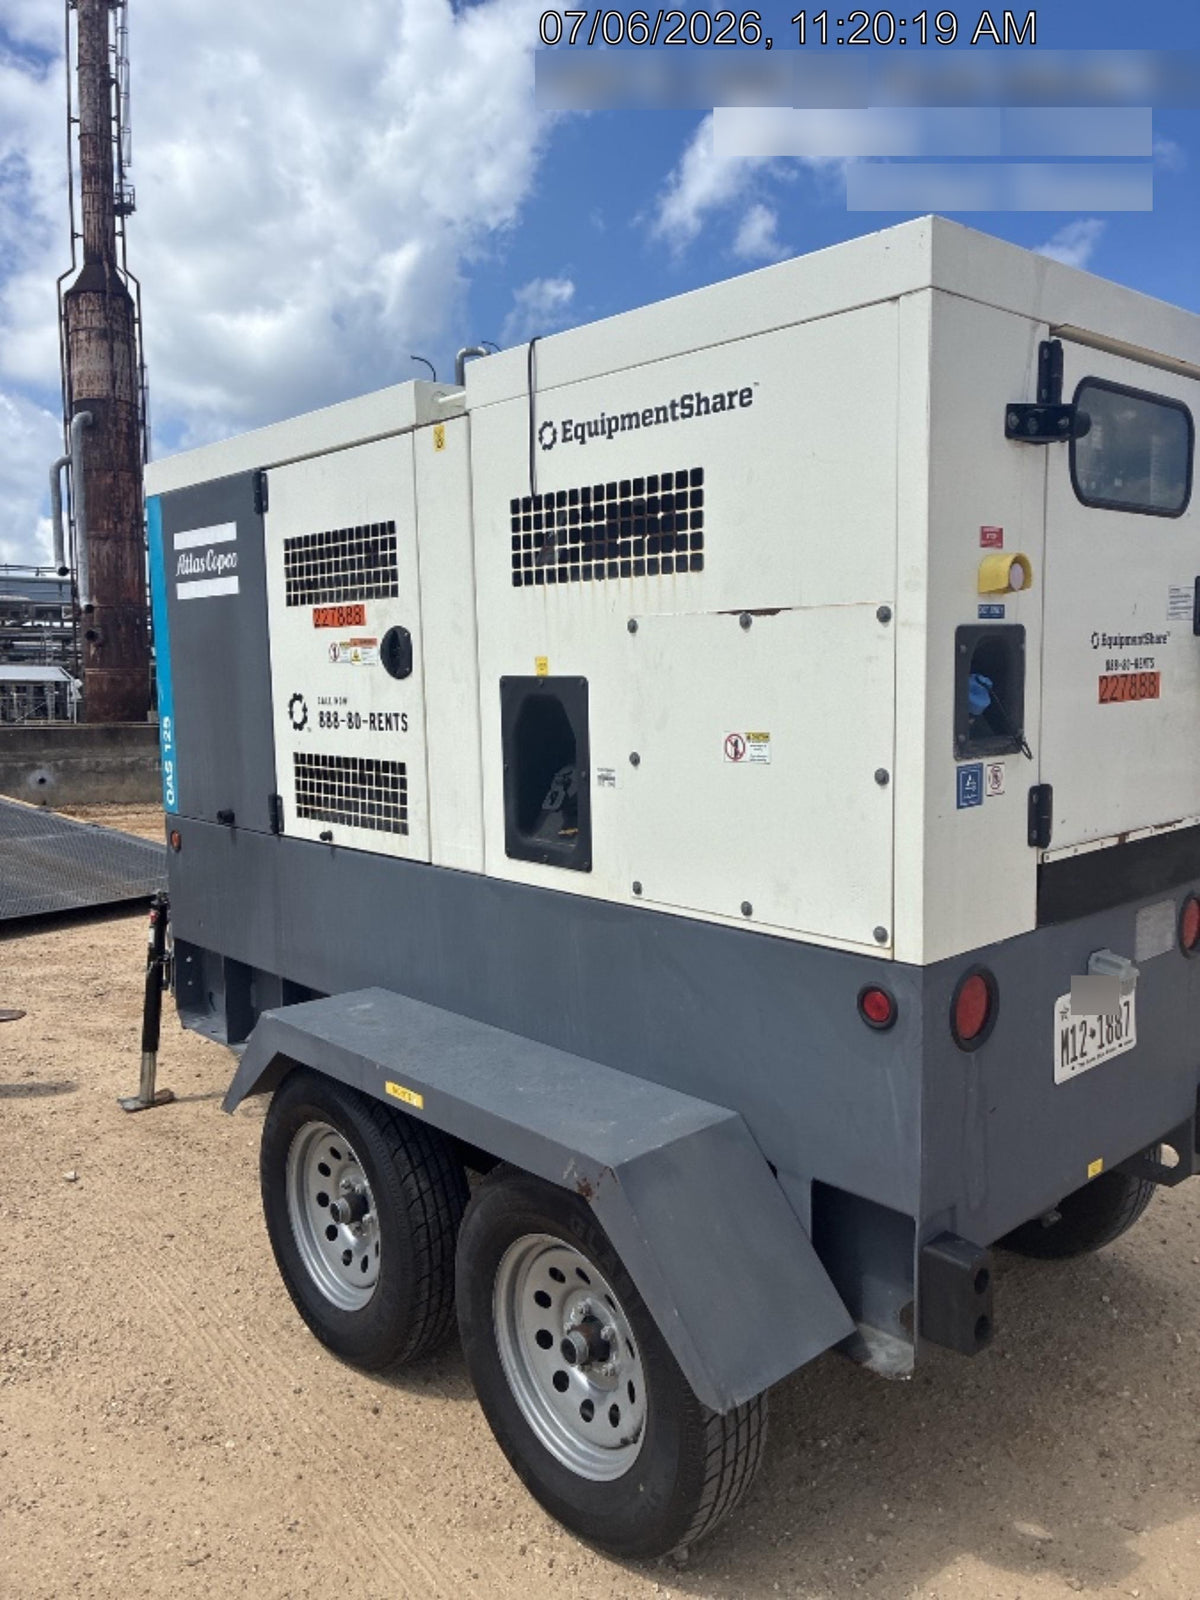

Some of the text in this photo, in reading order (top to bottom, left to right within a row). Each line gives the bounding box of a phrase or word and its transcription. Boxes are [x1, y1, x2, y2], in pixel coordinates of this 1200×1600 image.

[560, 385, 754, 445] EquipmentShare
[175, 548, 239, 576] Atlas Copco
[313, 604, 363, 628] 227888
[1101, 632, 1168, 649] EquipmentShare
[1099, 671, 1158, 703] 227888
[162, 715, 172, 753] 125
[318, 711, 409, 732] 888-80-RENTS
